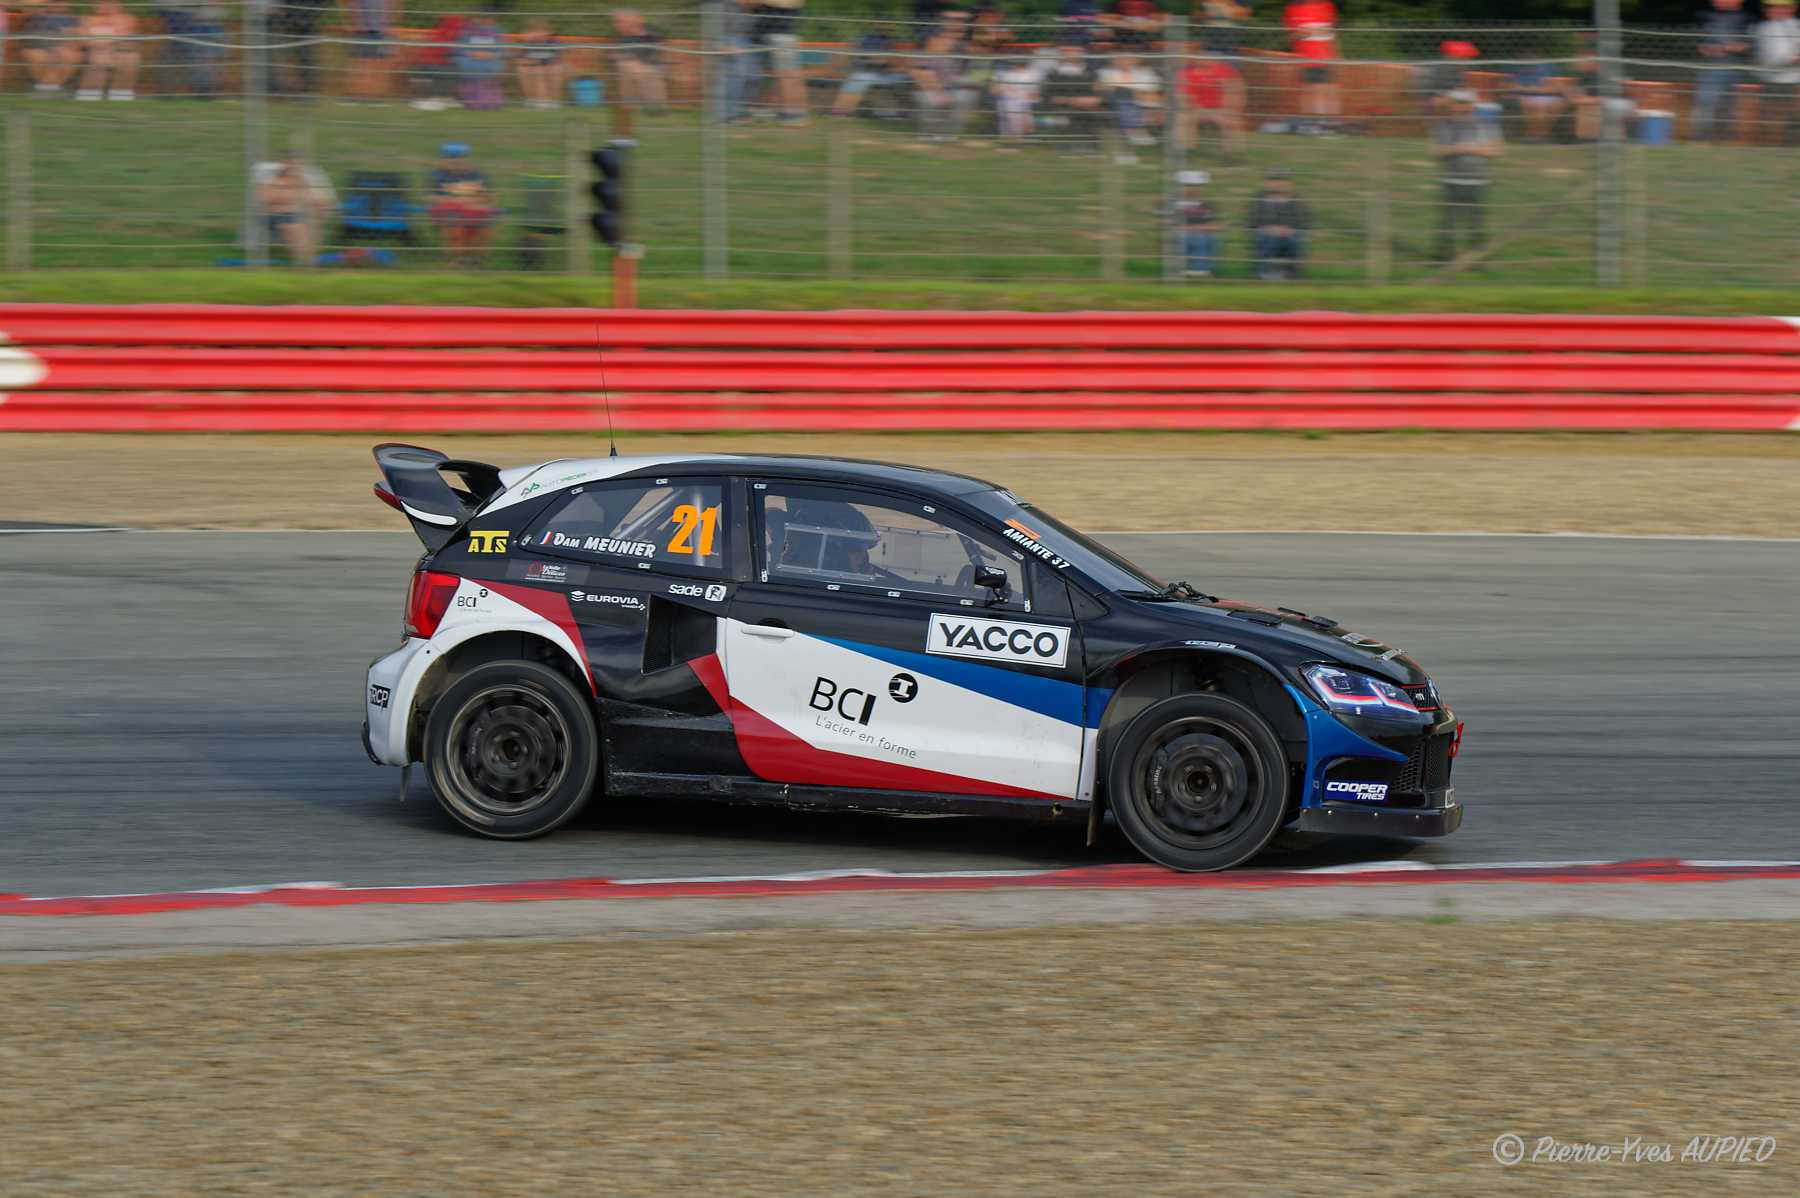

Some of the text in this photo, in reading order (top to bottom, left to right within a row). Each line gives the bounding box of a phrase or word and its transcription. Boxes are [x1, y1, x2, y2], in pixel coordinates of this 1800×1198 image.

[667, 504, 718, 556] 21
[468, 531, 510, 552] ATS
[584, 537, 656, 558] MEUNIER
[1002, 528, 1070, 569] AMIANTE 37
[586, 594, 639, 604] EUROVIA
[668, 584, 703, 597] sade
[457, 596, 477, 608] BCI
[939, 622, 1059, 658] YACCO
[808, 676, 877, 726] BCI
[815, 714, 917, 759] L'acier en forme
[1326, 781, 1388, 793] COOPER
